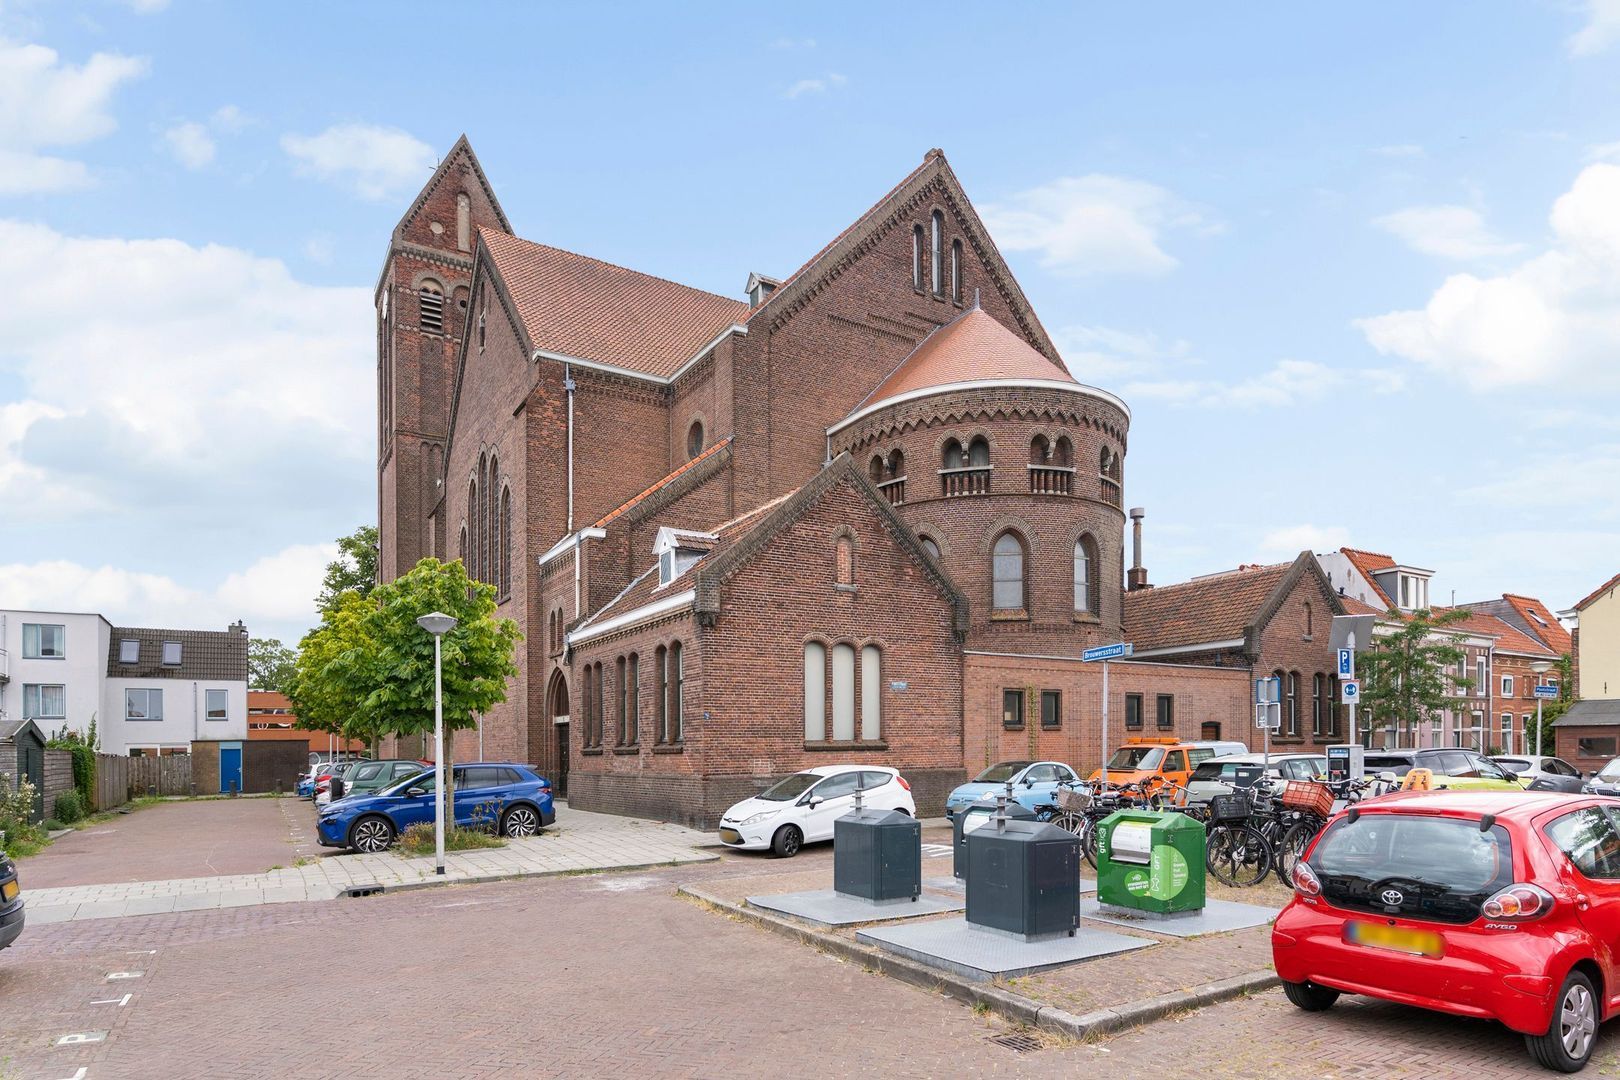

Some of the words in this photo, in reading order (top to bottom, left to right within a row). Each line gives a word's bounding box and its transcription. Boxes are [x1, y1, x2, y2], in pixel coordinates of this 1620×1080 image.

[1084, 646, 1122, 659] Brouwersstraat
[1341, 651, 1348, 664] P
[1099, 841, 1107, 854] gft
